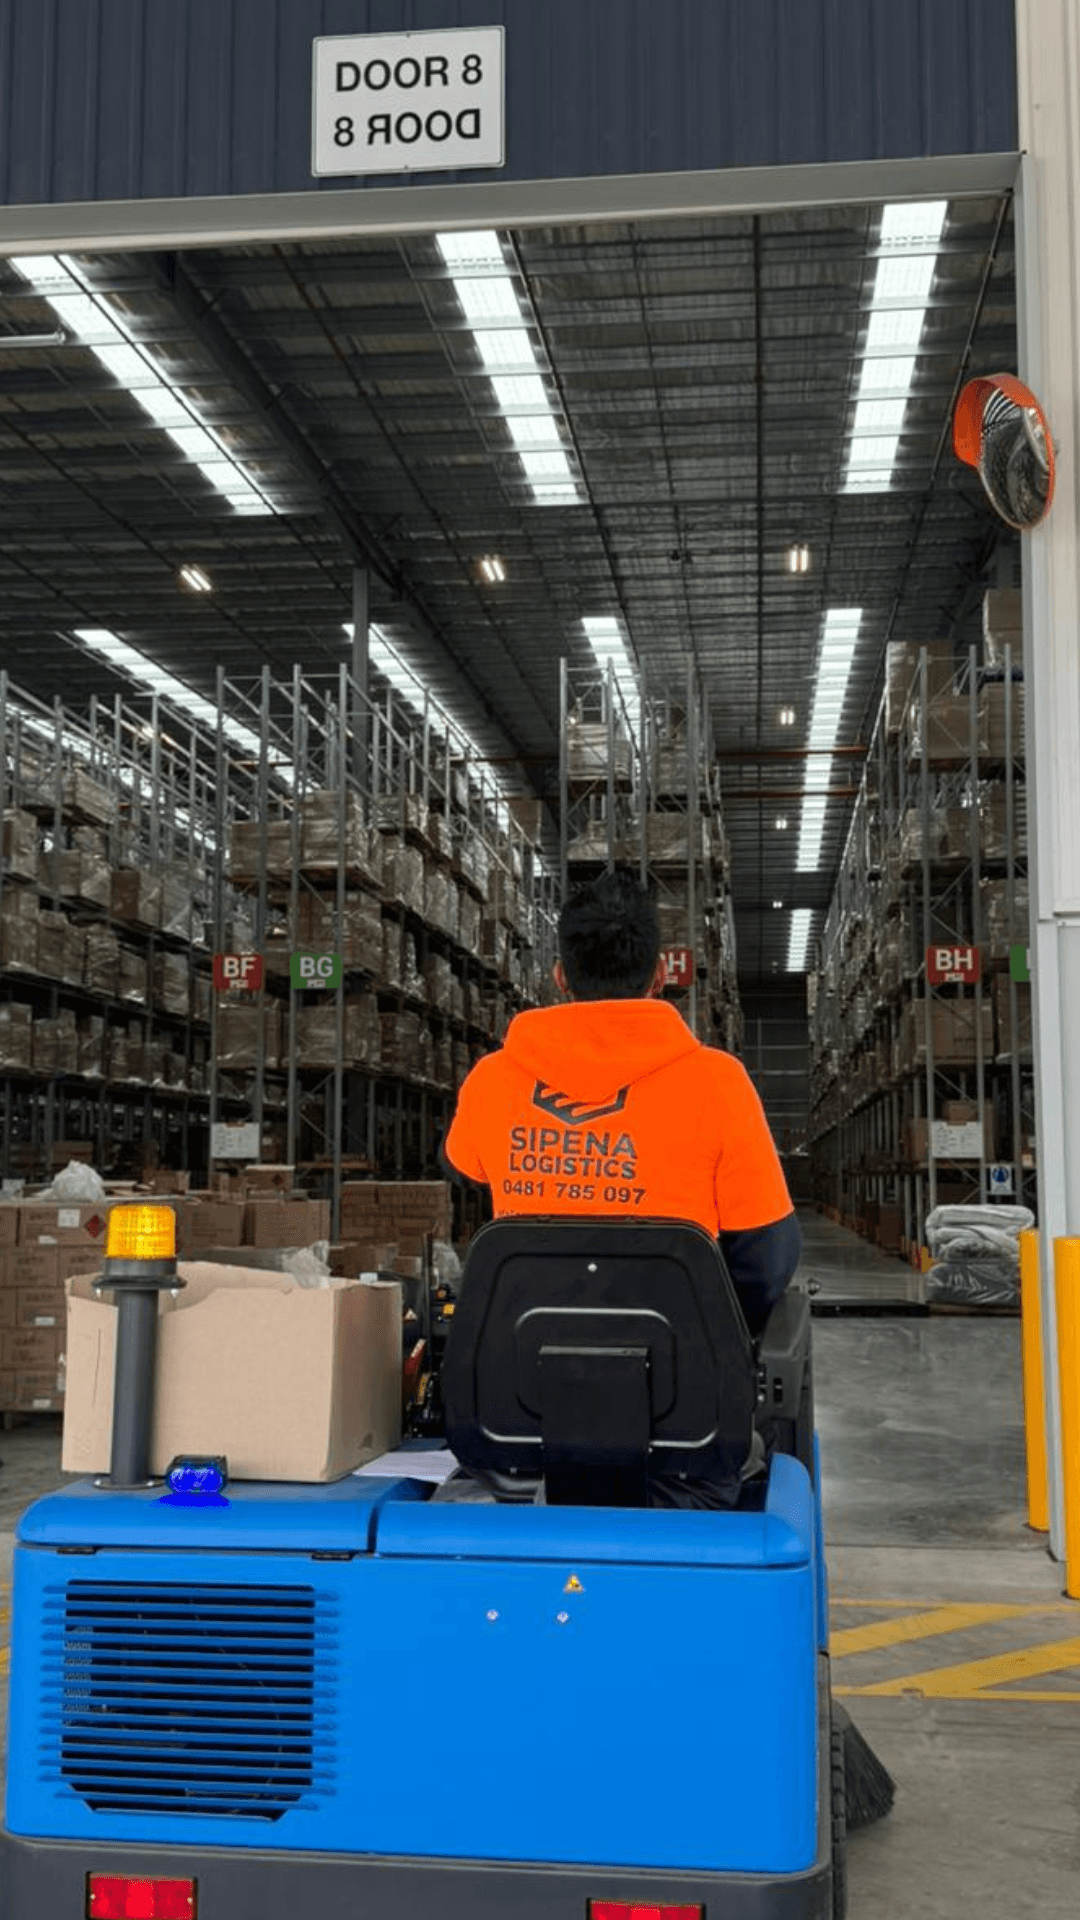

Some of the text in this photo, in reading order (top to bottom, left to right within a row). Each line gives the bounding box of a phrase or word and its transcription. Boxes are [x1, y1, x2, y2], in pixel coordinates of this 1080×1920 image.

[336, 54, 482, 92] DOOR 8
[223, 956, 257, 978] BF
[299, 956, 334, 978] BG
[936, 948, 973, 971] BH
[511, 1126, 638, 1160] SIPENA
[509, 1152, 637, 1180] LOGISTICS
[502, 1179, 647, 1205] 0481 785 097
